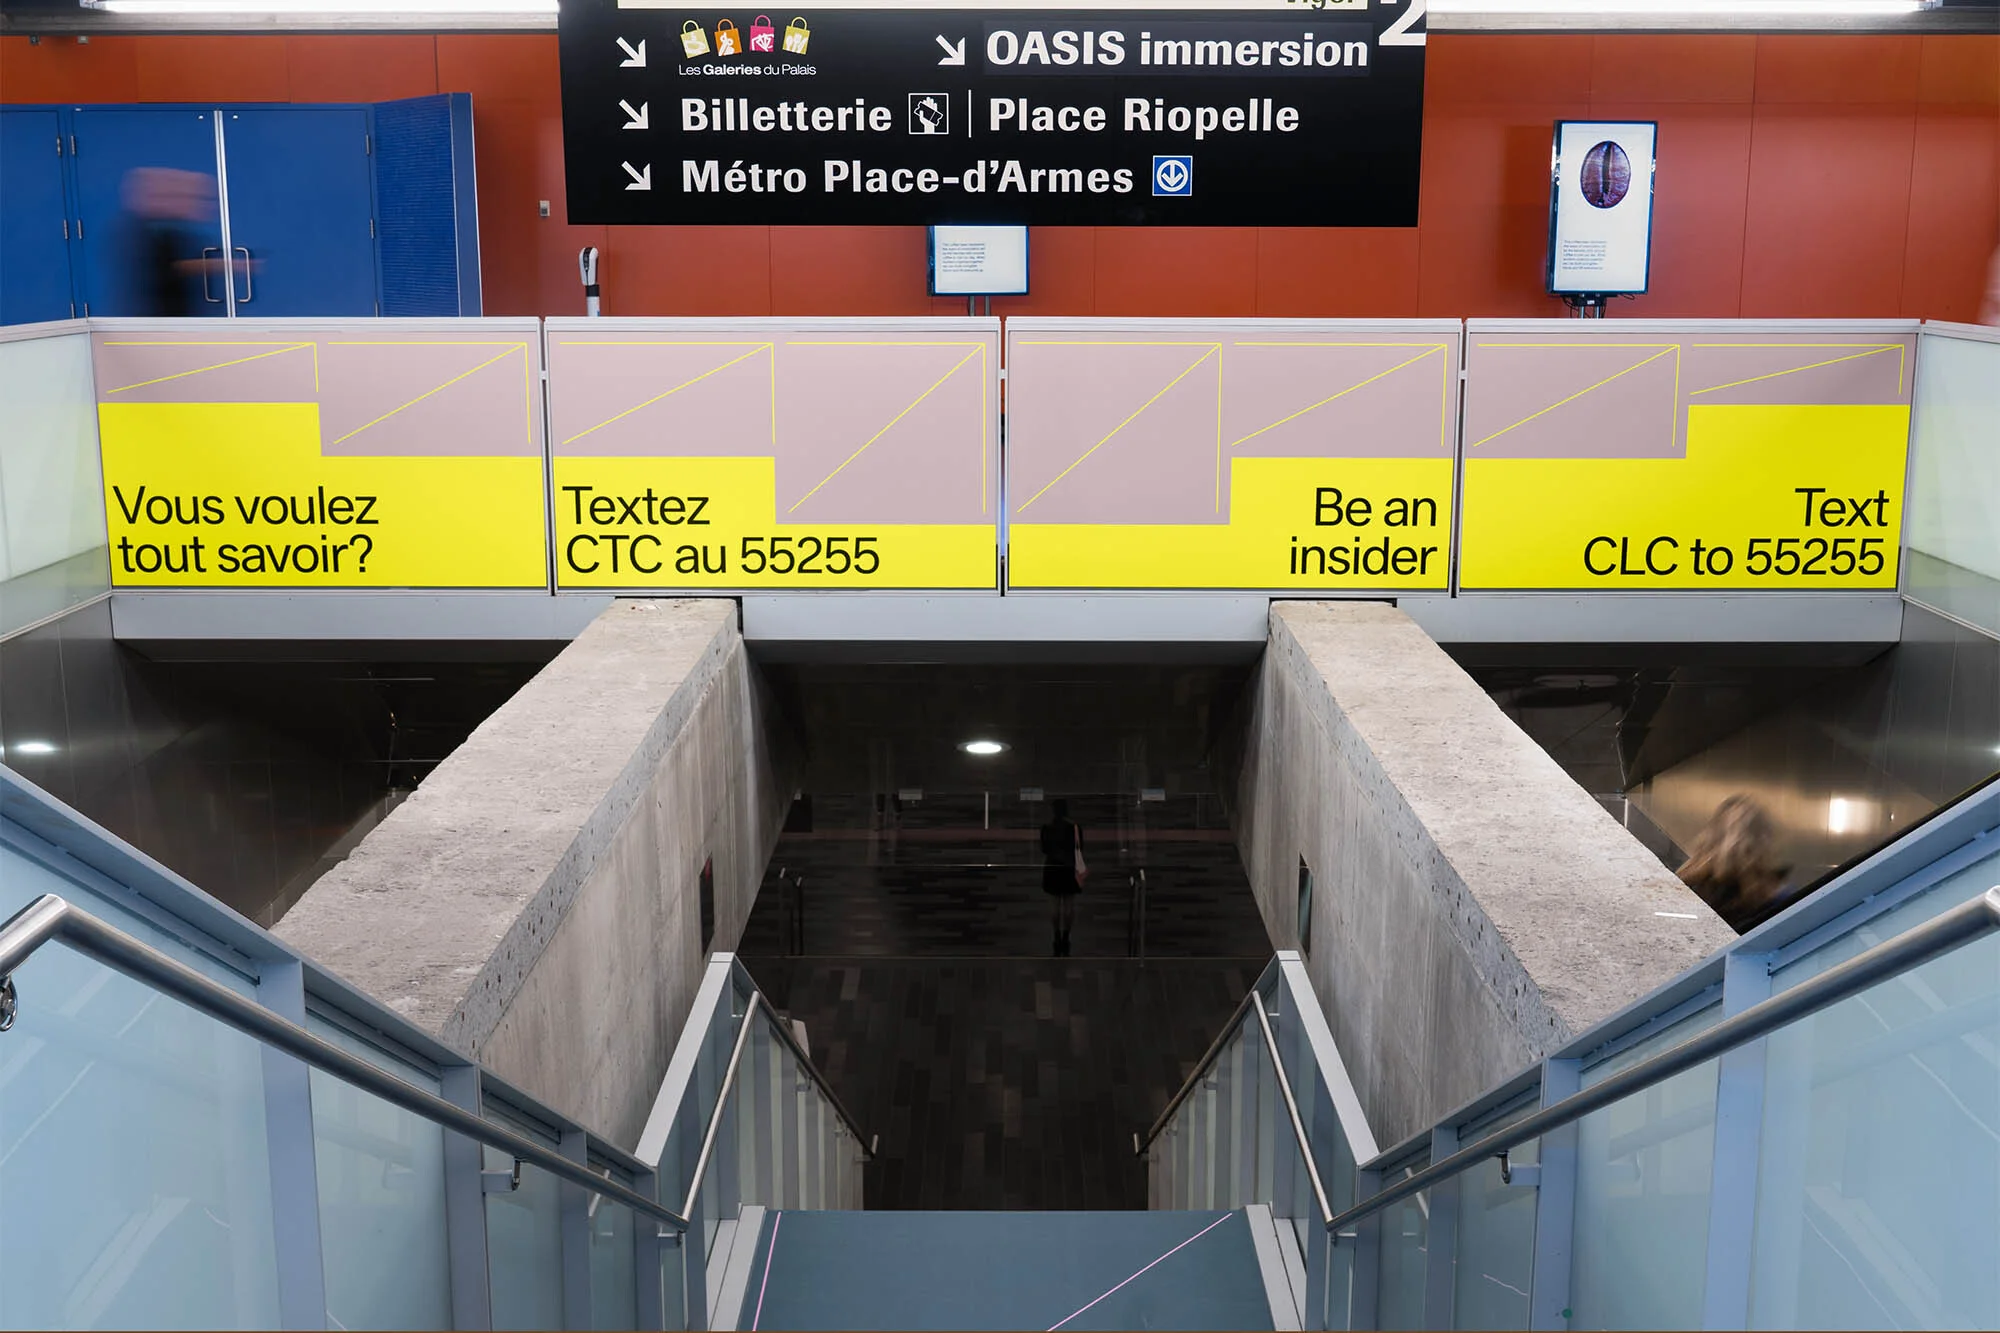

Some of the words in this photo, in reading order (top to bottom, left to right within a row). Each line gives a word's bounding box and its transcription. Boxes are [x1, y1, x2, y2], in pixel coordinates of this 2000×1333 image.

[986, 30, 1126, 66] OASIS
[1140, 32, 1368, 67] immersion
[678, 64, 701, 76] Les
[702, 64, 762, 76] Galeries
[763, 64, 780, 76] du
[781, 64, 817, 76] Palais
[681, 98, 892, 132] Billetterie
[989, 97, 1106, 132] Place
[1124, 97, 1299, 140] Riopelle
[682, 159, 807, 193] Métro
[113, 486, 225, 525] Vous
[234, 486, 380, 525] voulez
[561, 486, 711, 525] Textez
[1314, 487, 1373, 527] Be
[1383, 497, 1437, 527] an
[1794, 487, 1890, 527] Text
[117, 536, 208, 573] tout
[217, 534, 373, 573] savoir?
[566, 534, 663, 574] CTC
[675, 545, 727, 574] au
[741, 536, 880, 575] 55255
[1290, 535, 1438, 575] insider
[1583, 536, 1680, 576] CLC
[1689, 538, 1734, 576] to
[1745, 537, 1885, 576] 55255
